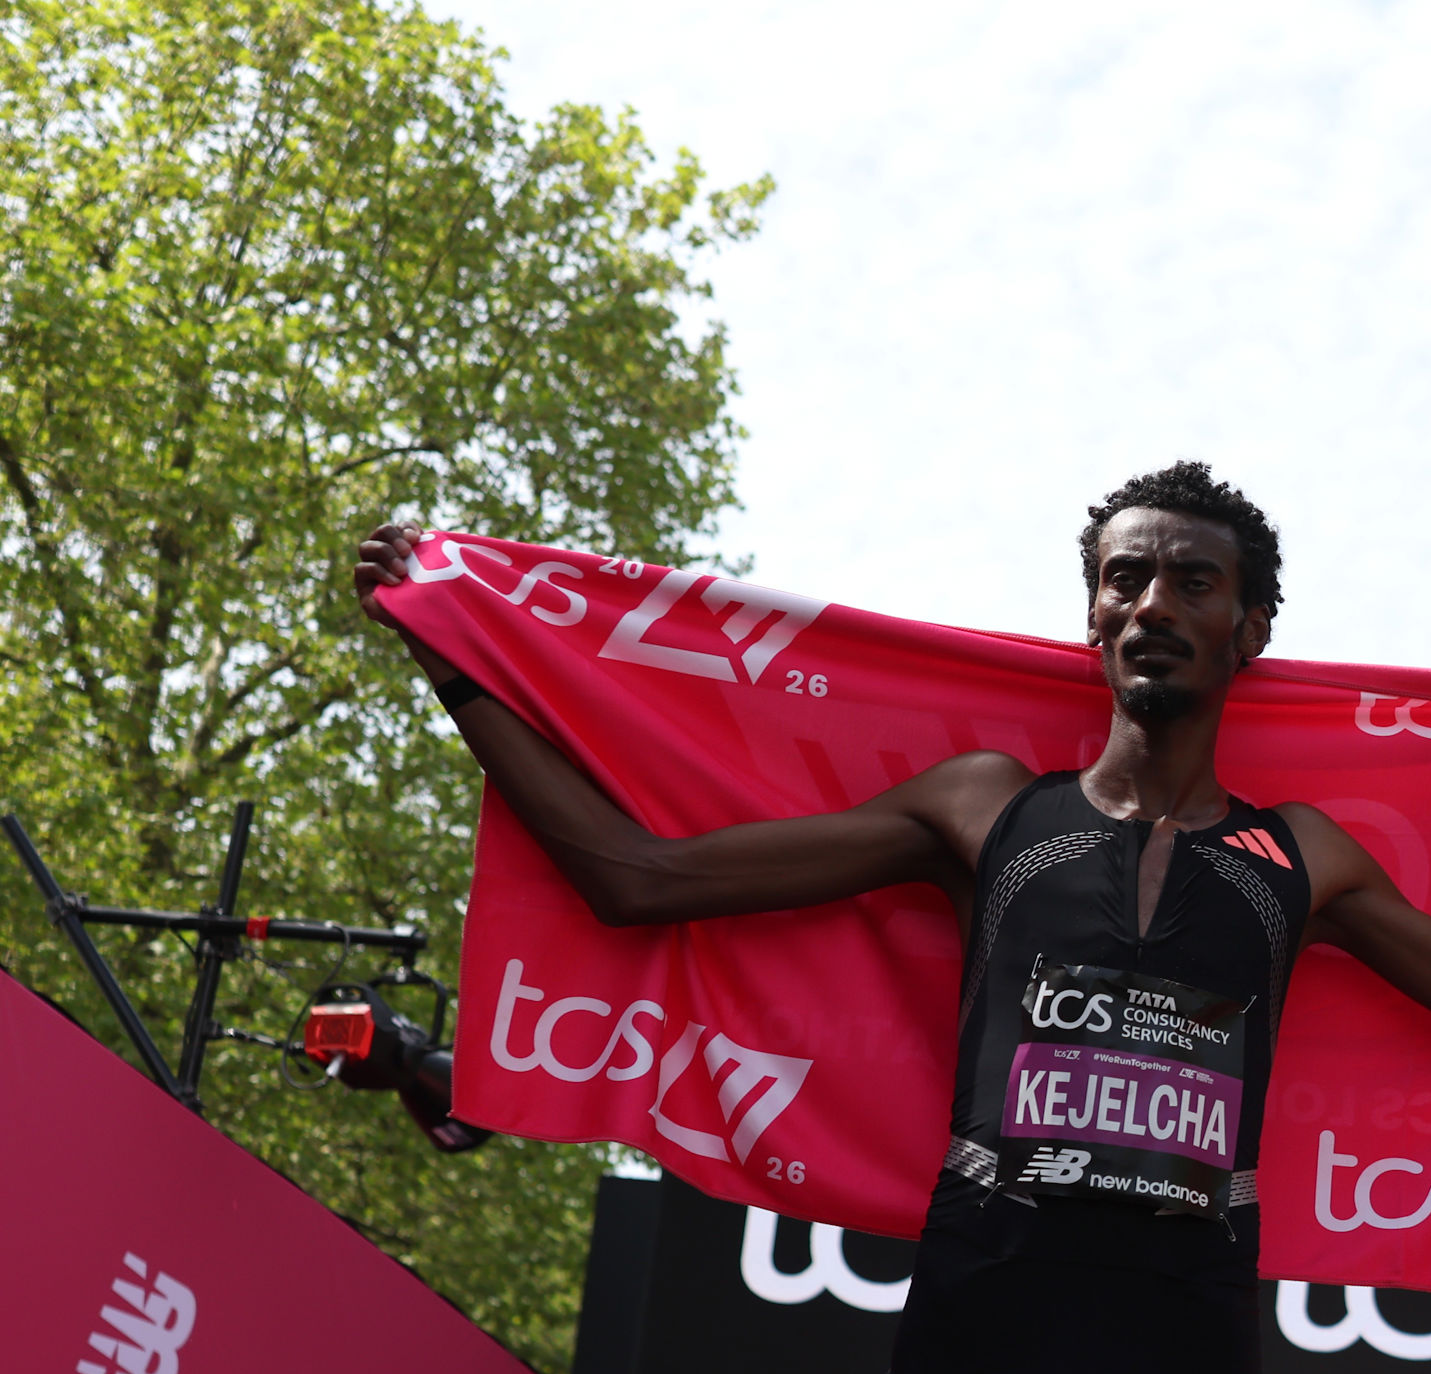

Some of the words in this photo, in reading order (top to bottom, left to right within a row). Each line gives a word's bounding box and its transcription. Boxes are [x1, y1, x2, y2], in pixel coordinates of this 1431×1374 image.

[785, 669, 828, 698] 26
[1031, 980, 1114, 1033] tcs
[1127, 988, 1177, 1012] TATA
[1121, 1024, 1193, 1050] SERVICES
[1122, 1007, 1230, 1045] CONSULTANCY
[490, 958, 666, 1082] tcs
[767, 1157, 806, 1184] 26
[1093, 1052, 1171, 1073] #WeRunTogether
[1014, 1069, 1226, 1156] KEJELCHA
[1089, 1173, 1132, 1191] new
[1136, 1176, 1208, 1207] balance
